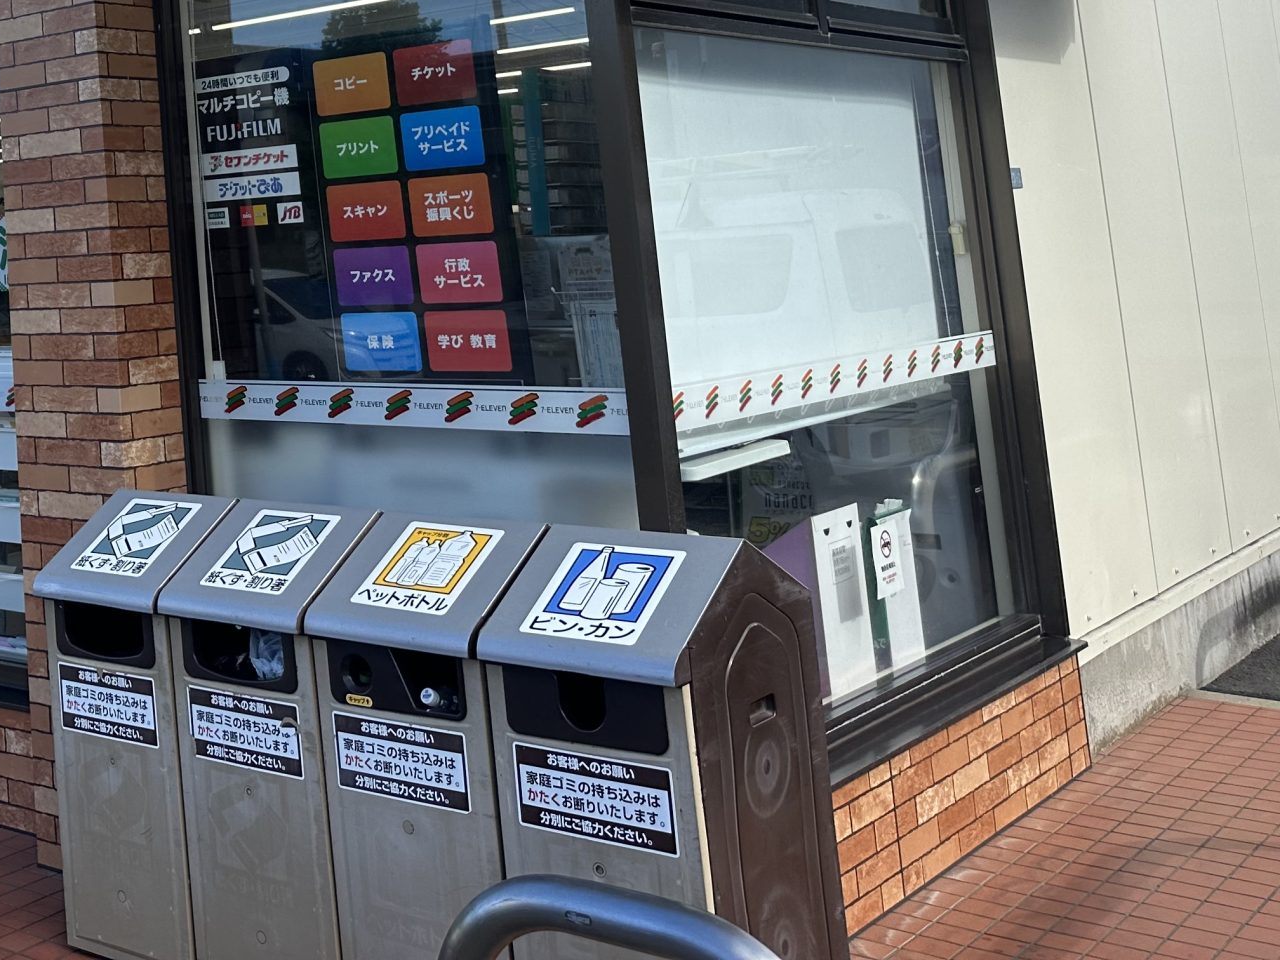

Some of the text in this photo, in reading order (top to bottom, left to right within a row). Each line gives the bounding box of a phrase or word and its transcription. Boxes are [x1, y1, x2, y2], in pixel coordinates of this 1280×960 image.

[201, 70, 279, 90] 24時間いつでも便利
[411, 63, 456, 80] チケット
[334, 76, 368, 91] コピー
[197, 87, 290, 114] マルチコピー機
[411, 122, 470, 139] プリペイド
[336, 141, 379, 157] プリント
[418, 139, 468, 156] サービス
[224, 150, 288, 168] セブンチケット
[219, 176, 283, 197] チケットぴあ
[424, 190, 473, 206] スポーツ
[280, 205, 301, 222] JTB
[343, 205, 388, 219] スキャン
[426, 206, 475, 223] 振興くじ
[444, 258, 470, 272] 行政
[350, 268, 396, 283] ファクス
[434, 274, 485, 289] サービス
[367, 335, 395, 349] 保険
[438, 334, 497, 349] 学び 教育
[248, 396, 274, 405] 7-ELEVEN
[300, 398, 327, 406] 7-ELEVEN
[355, 400, 384, 408] 7-ELEVEN
[475, 404, 507, 413] 7-ELEVEN
[540, 406, 575, 415] 7-ELEVEN
[357, 588, 449, 612] ペットボトル
[528, 615, 635, 640] ビン・カン
[78, 670, 132, 688] お客様へのお願い
[65, 686, 148, 710] 家庭ゴミの持ち込みは
[210, 694, 273, 715] お客様へのお願い
[66, 698, 151, 726] かたくお断りいたします。
[74, 717, 144, 740] 分別にご協力ください。
[361, 721, 434, 744] お客様へのお願い
[197, 724, 295, 756] かたくお断りいたします。
[206, 744, 286, 771] 分別にご協力ください。
[344, 738, 456, 770] 家庭ゴミの持ち込みは
[344, 753, 460, 788] かたくお断りいたします。
[547, 753, 635, 780] お客様へのお願い
[355, 775, 449, 804] 分別にご協力ください。
[526, 771, 661, 808] 家庭ゴミの持ち込みは
[527, 788, 665, 828] かたくお断りいたします。
[540, 811, 653, 846] 分別にご協力ください。
